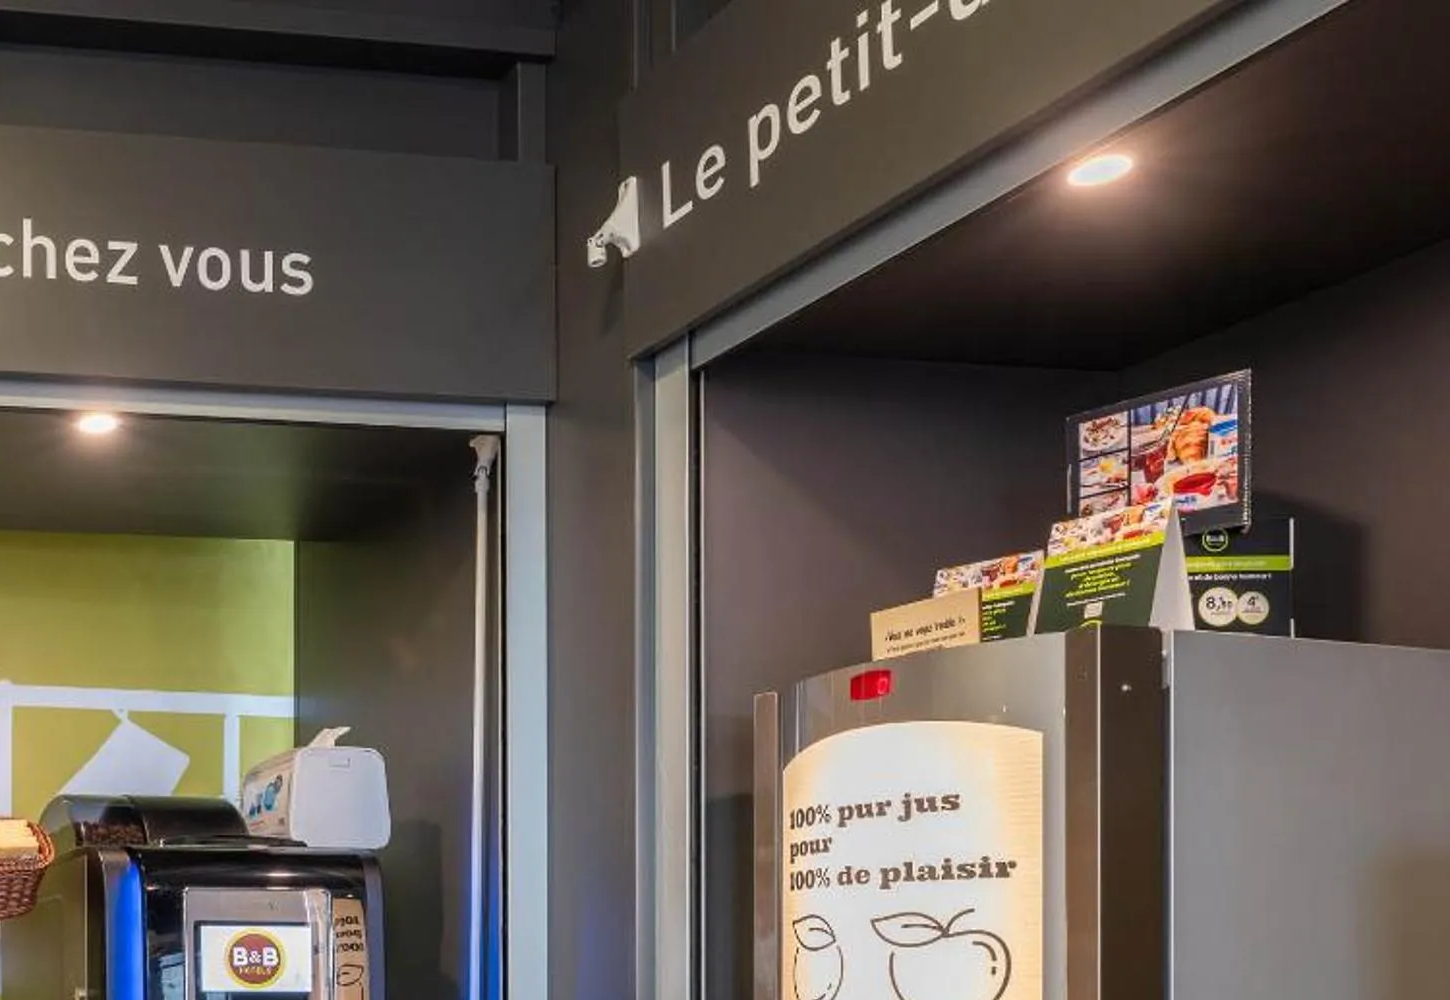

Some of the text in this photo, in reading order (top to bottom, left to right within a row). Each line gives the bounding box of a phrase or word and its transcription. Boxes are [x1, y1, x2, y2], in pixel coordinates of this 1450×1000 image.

[661, 143, 727, 230] Le
[158, 244, 314, 297] vous
[789, 793, 961, 829] 100% pur jus
[789, 836, 833, 864] pour
[789, 855, 1018, 891] 100% de plaisir
[232, 946, 280, 967] B&B
